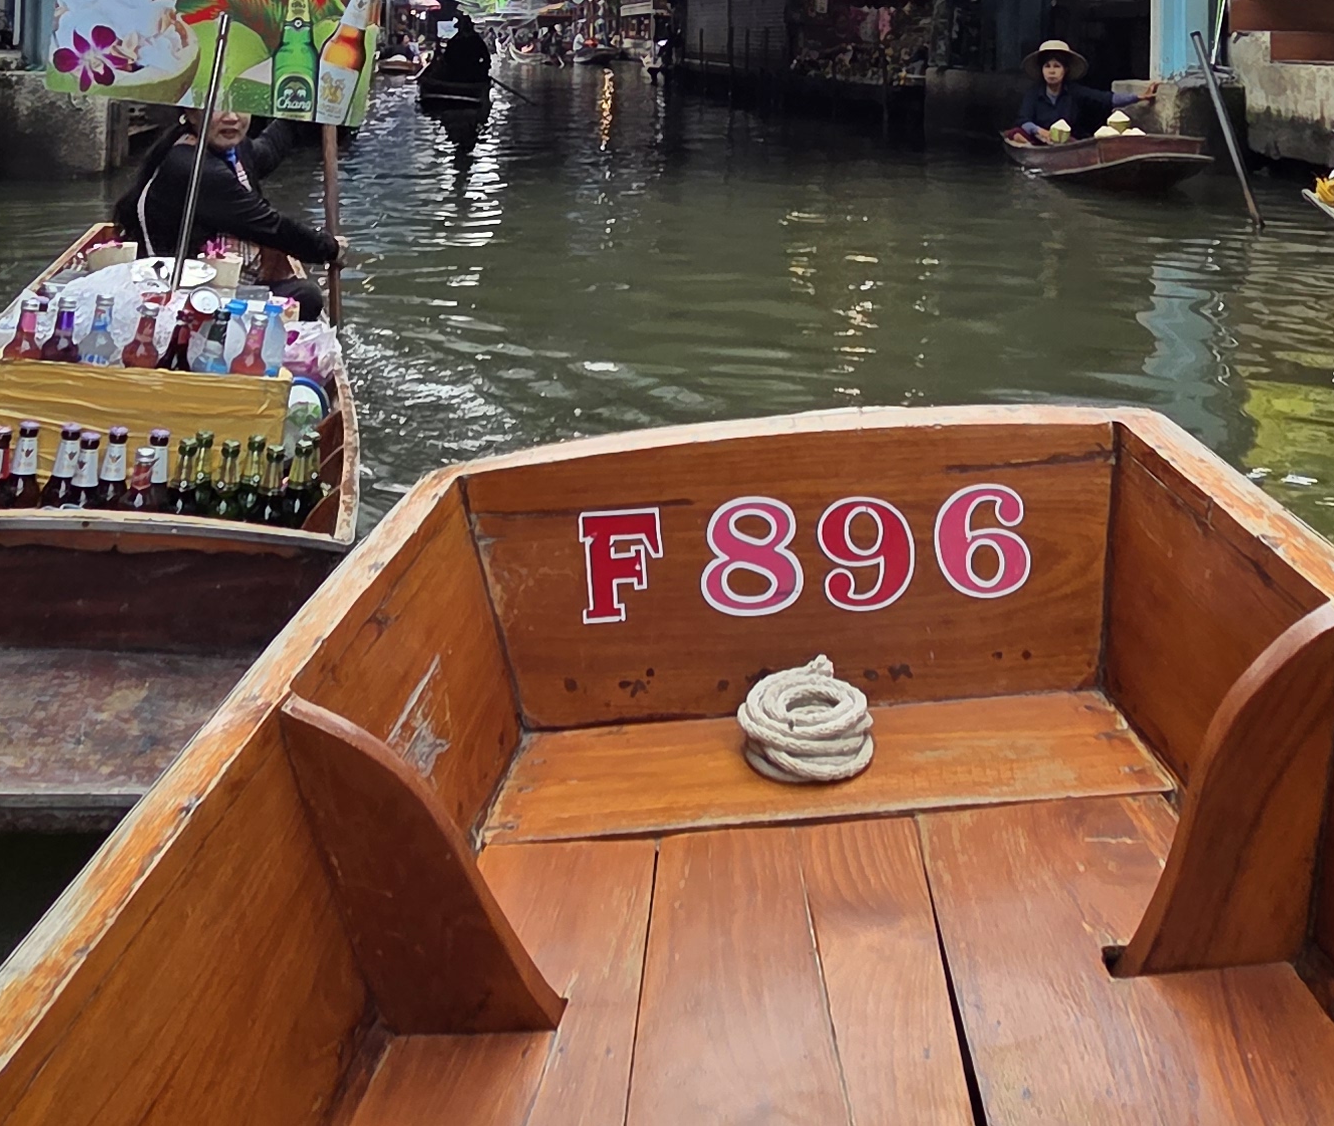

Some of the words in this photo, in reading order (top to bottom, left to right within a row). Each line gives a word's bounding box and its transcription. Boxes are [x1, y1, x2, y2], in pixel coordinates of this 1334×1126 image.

[276, 95, 312, 111] Chang
[578, 507, 664, 624] F
[700, 483, 1031, 617] 896
